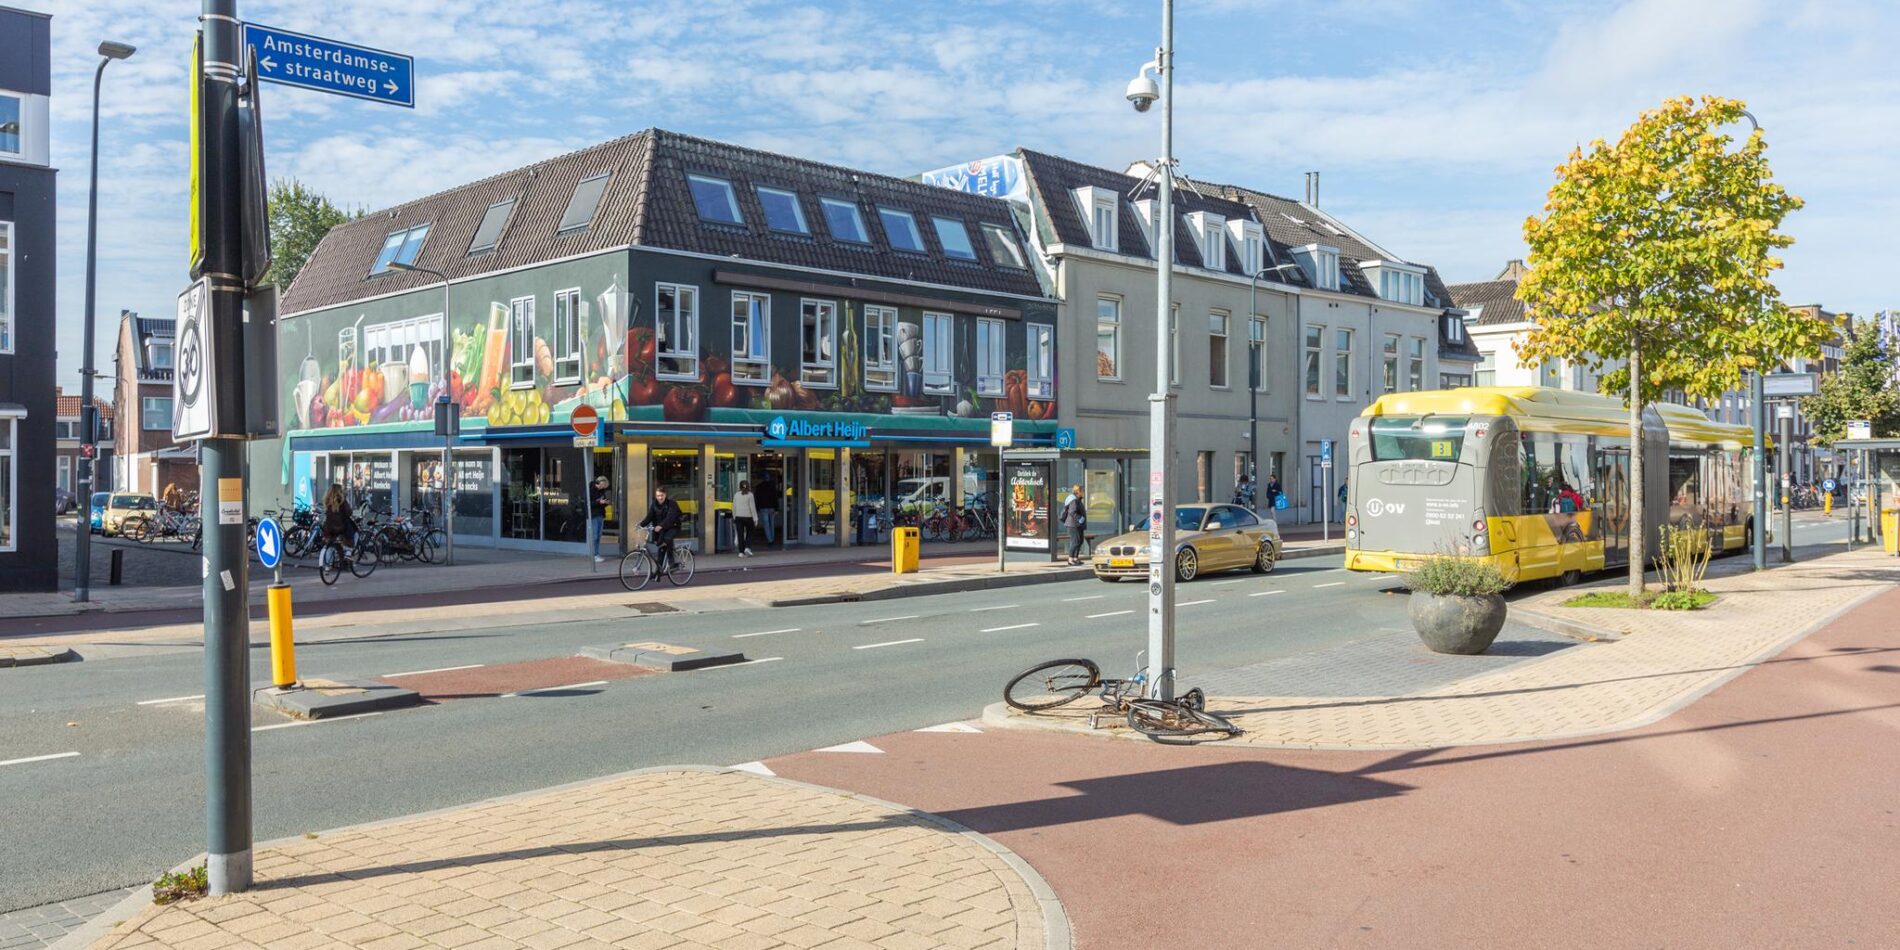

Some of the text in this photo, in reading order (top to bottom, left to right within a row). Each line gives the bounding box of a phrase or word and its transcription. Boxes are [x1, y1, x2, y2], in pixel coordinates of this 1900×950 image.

[264, 35, 395, 73] Amsterdamse-
[286, 62, 377, 93] straatweg
[183, 294, 198, 313] ZONE
[182, 344, 198, 380] 30
[789, 420, 832, 436] Albert
[835, 421, 867, 440] Heijn
[458, 470, 472, 479] Alert
